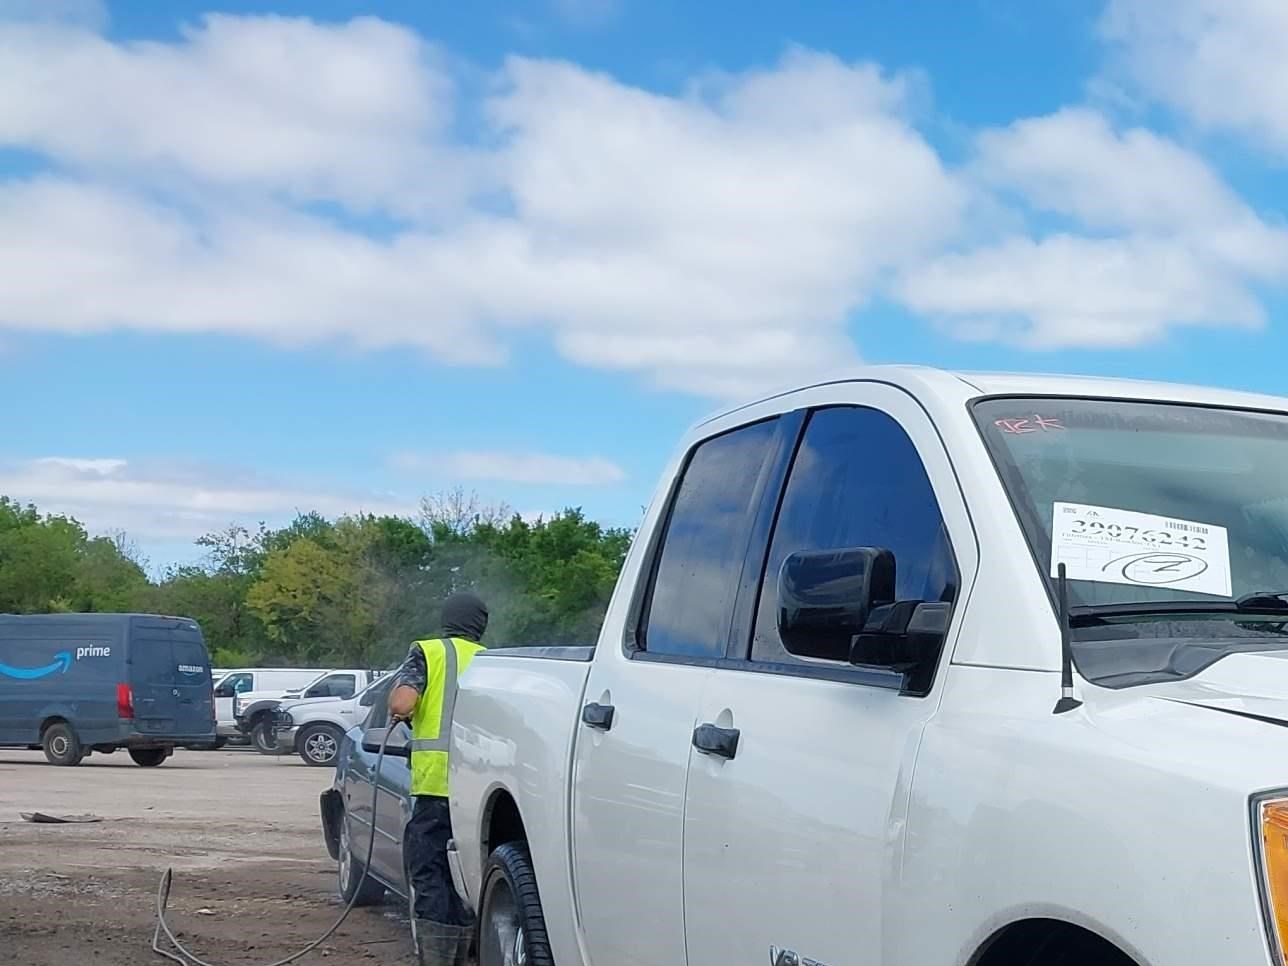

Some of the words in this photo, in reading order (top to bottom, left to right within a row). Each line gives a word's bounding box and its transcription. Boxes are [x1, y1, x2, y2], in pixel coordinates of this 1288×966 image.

[1071, 519, 1208, 551] 39076242
[76, 644, 111, 660] prime
[178, 665, 204, 673] amazon
